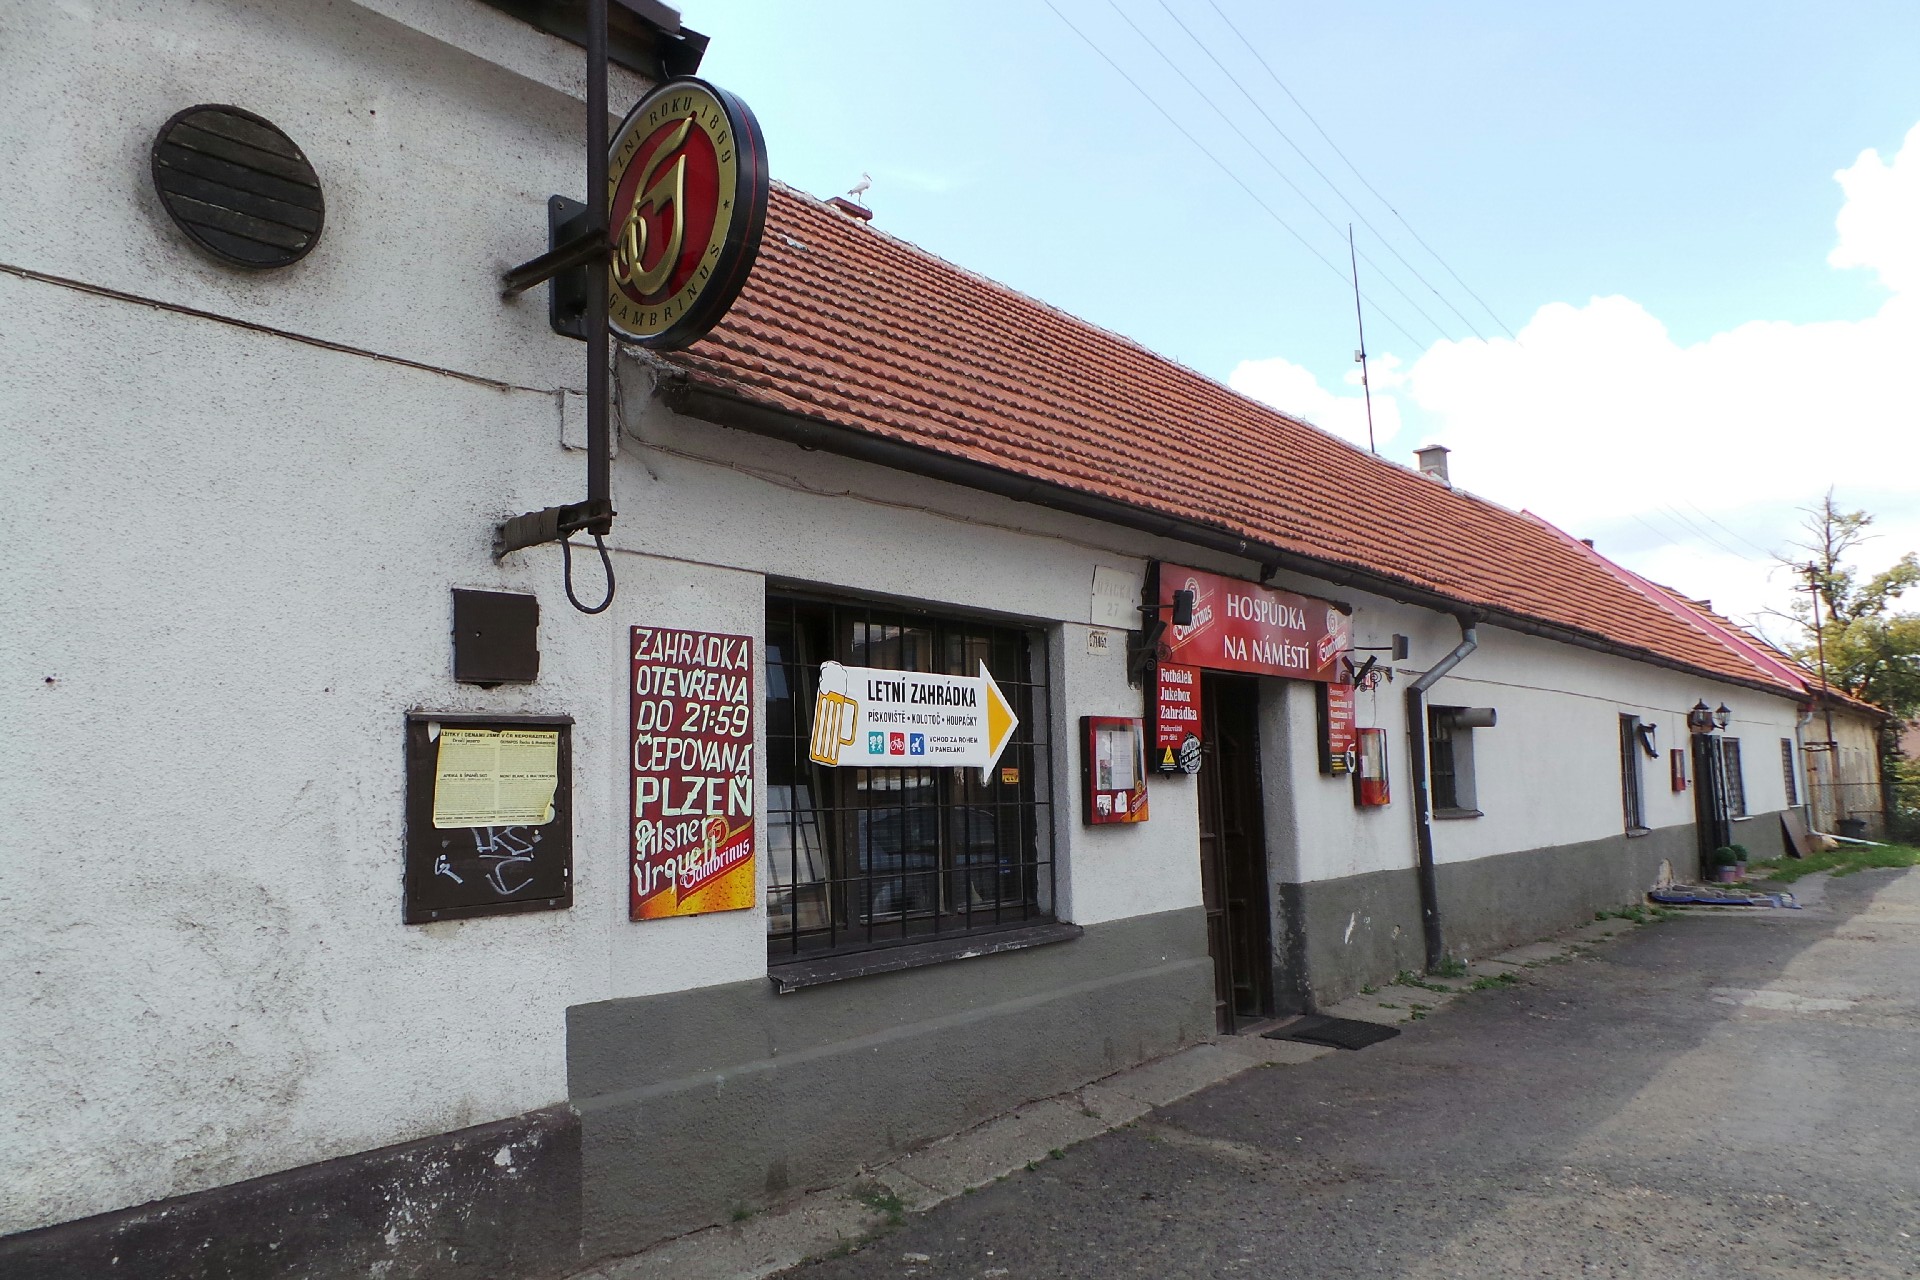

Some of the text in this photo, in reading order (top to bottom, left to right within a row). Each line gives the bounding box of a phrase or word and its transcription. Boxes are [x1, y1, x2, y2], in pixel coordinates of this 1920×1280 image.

[609, 97, 732, 185] LZNI ROKU 1869
[609, 244, 720, 327] GAMBRINUS
[1227, 593, 1306, 631] HOSPŮDKA
[634, 629, 749, 672] ZAHRÁDKA
[1224, 634, 1310, 670] NA NÁMĚSTÍ
[636, 666, 748, 705] OTEVŘENA
[867, 677, 977, 708] LETNÍ ZAHRÁDKA
[1160, 668, 1193, 684] Fotbálek
[1160, 686, 1191, 702] Jukebox
[636, 700, 750, 738] DO 21:59
[868, 708, 977, 727] PÍSKOVIŠTĚ KOLOTOČ HOUPAČKY
[1160, 705, 1197, 720] Zahrádka
[634, 733, 753, 776] ČEPOVANÁ
[929, 735, 949, 743] VCHOD
[635, 776, 753, 818] PLZEŇ
[634, 817, 716, 862] Pilsner
[633, 835, 717, 897] Urquell
